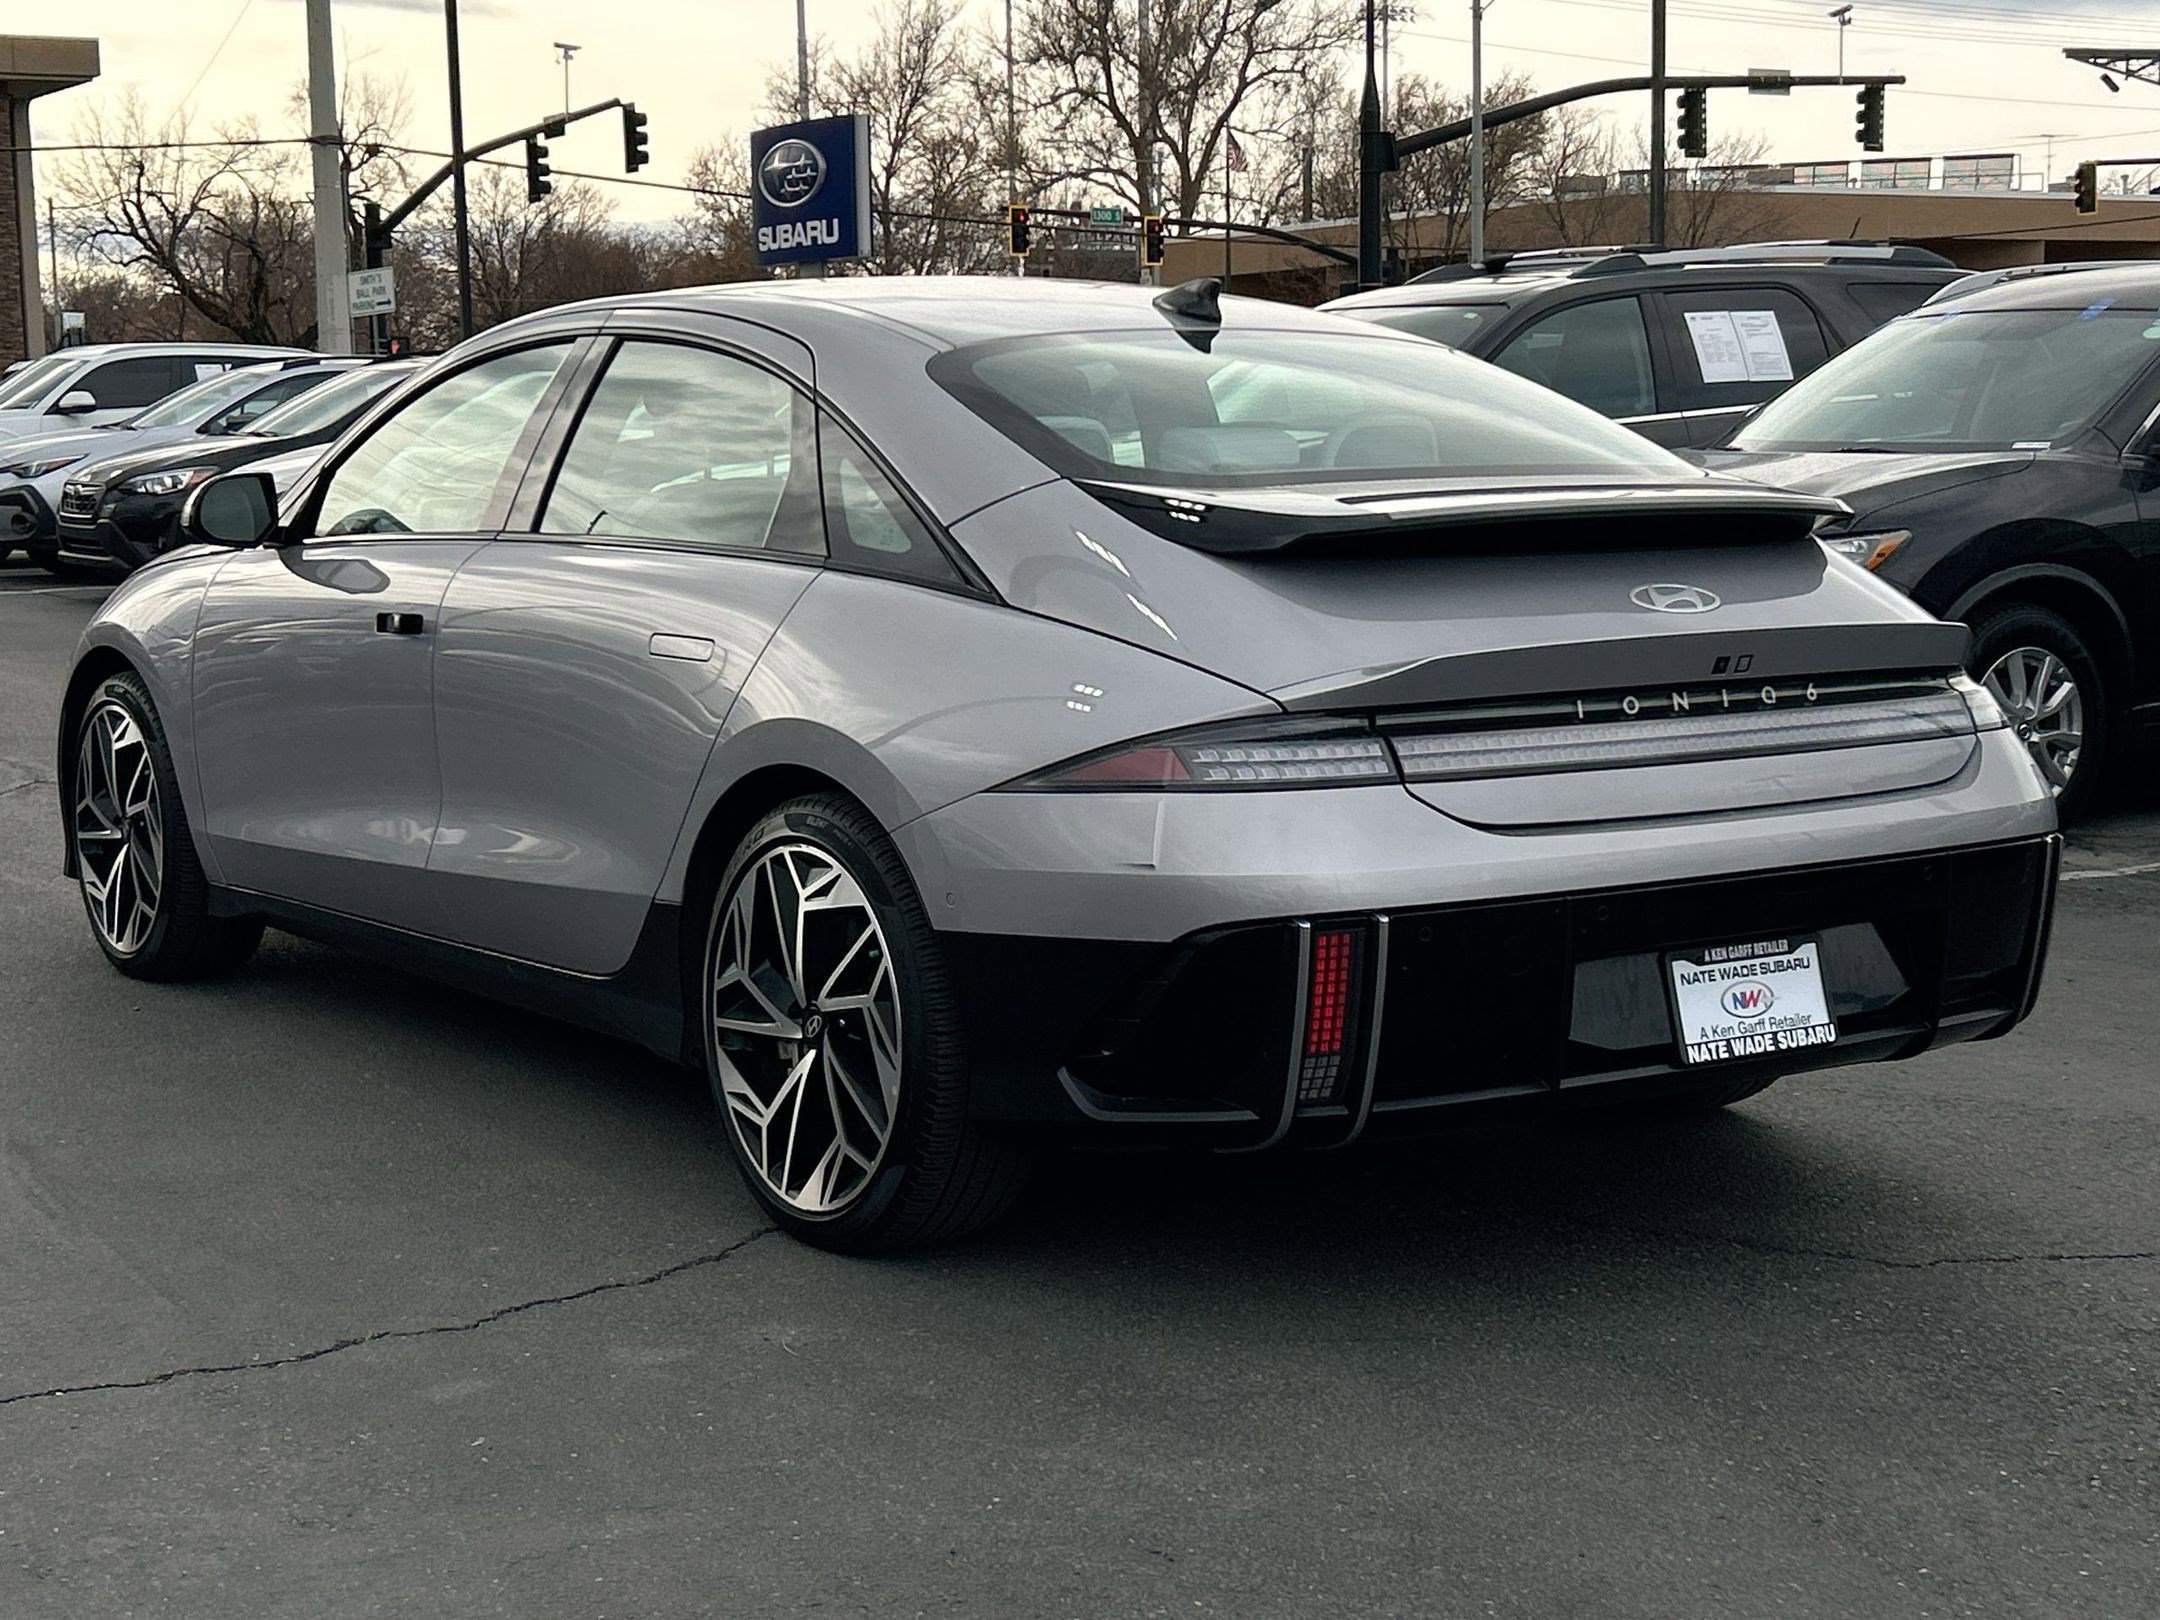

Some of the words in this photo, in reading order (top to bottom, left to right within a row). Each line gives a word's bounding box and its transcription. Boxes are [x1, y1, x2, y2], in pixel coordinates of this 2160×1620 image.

[758, 218, 839, 252] SUBARU
[356, 287, 371, 299] BALL
[372, 285, 387, 297] PARK
[360, 272, 382, 286] SMITH'S
[1577, 686, 1776, 718] IONIQ
[1806, 683, 1818, 700] 6
[1704, 950, 1710, 962] A
[1711, 948, 1728, 960] KEN
[1728, 944, 1752, 959] GARFF
[1754, 939, 1788, 955] RETAILER
[1680, 969, 1716, 986] NATE
[1718, 964, 1759, 981] WADE
[1759, 957, 1810, 975] SUBARU
[1732, 989, 1762, 1010] NW
[1700, 1026, 1709, 1041] A
[1711, 1023, 1735, 1039] Ken
[1737, 1017, 1767, 1035] Garff
[1769, 1013, 1812, 1030] Retailer
[1687, 1041, 1730, 1064] NATE
[1730, 1033, 1775, 1057] WADE
[1776, 1024, 1837, 1050] SUBARU
